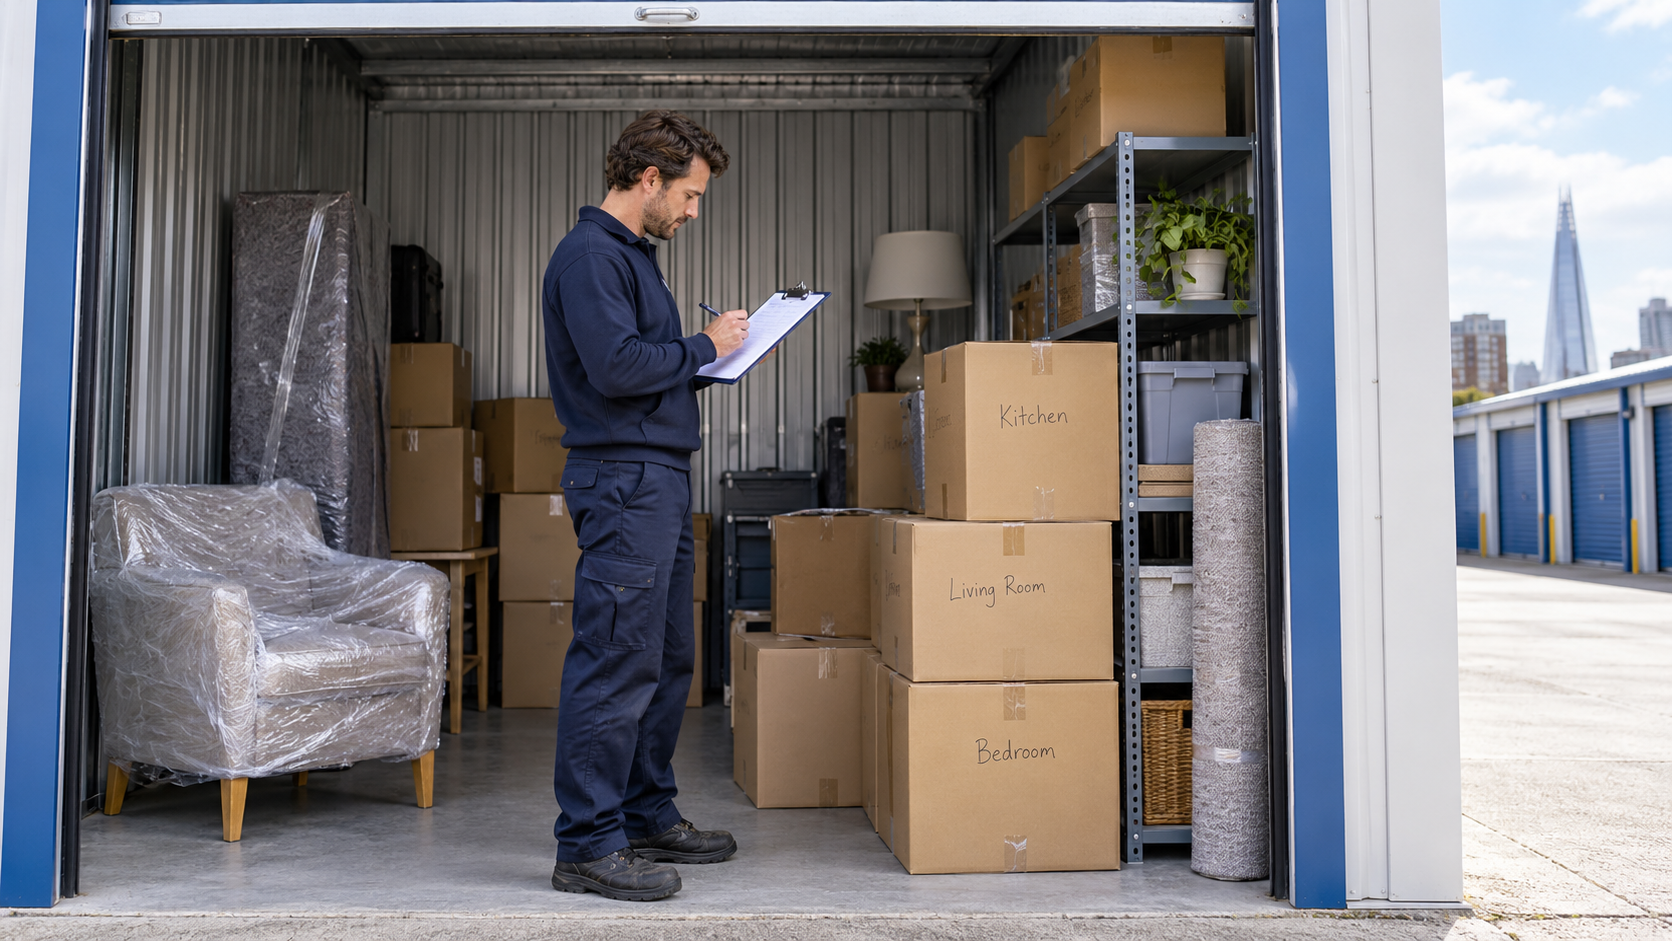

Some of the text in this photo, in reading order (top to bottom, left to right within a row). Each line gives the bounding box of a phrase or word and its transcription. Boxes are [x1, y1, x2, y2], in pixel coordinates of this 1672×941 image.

[1000, 403, 1069, 430] Kitchen
[949, 574, 1047, 609] Living Room
[976, 737, 1056, 765] Bedroom
